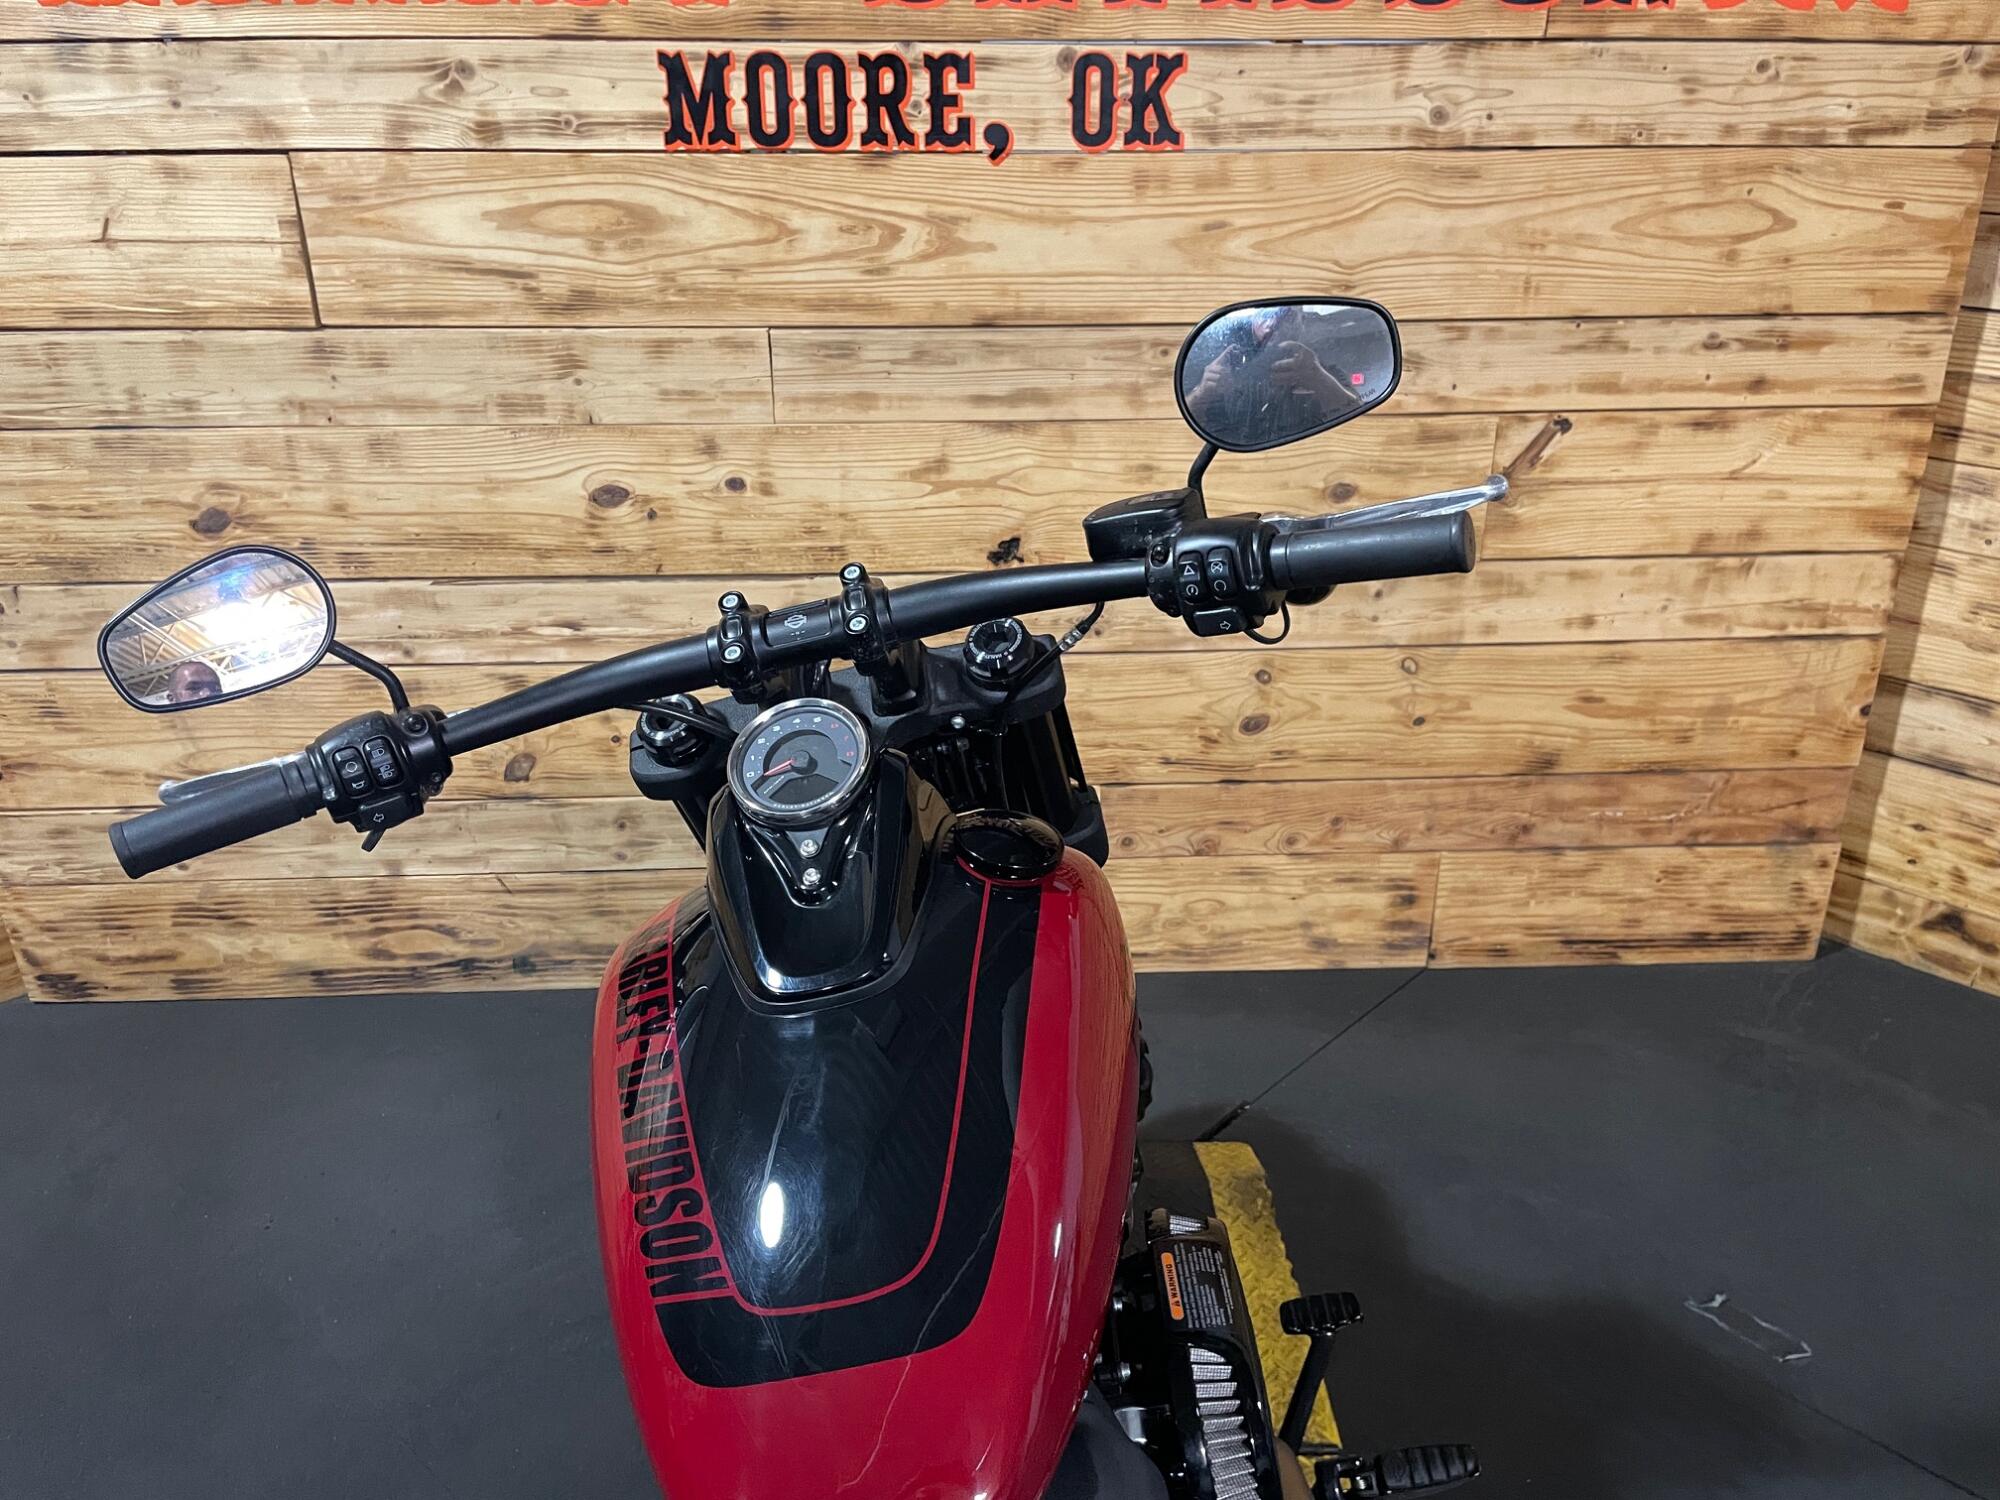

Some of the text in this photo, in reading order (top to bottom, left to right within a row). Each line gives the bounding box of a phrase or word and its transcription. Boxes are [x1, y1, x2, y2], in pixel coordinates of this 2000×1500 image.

[656, 50, 1188, 166] MOORE, OK
[1165, 1263, 1180, 1299] WARNING
